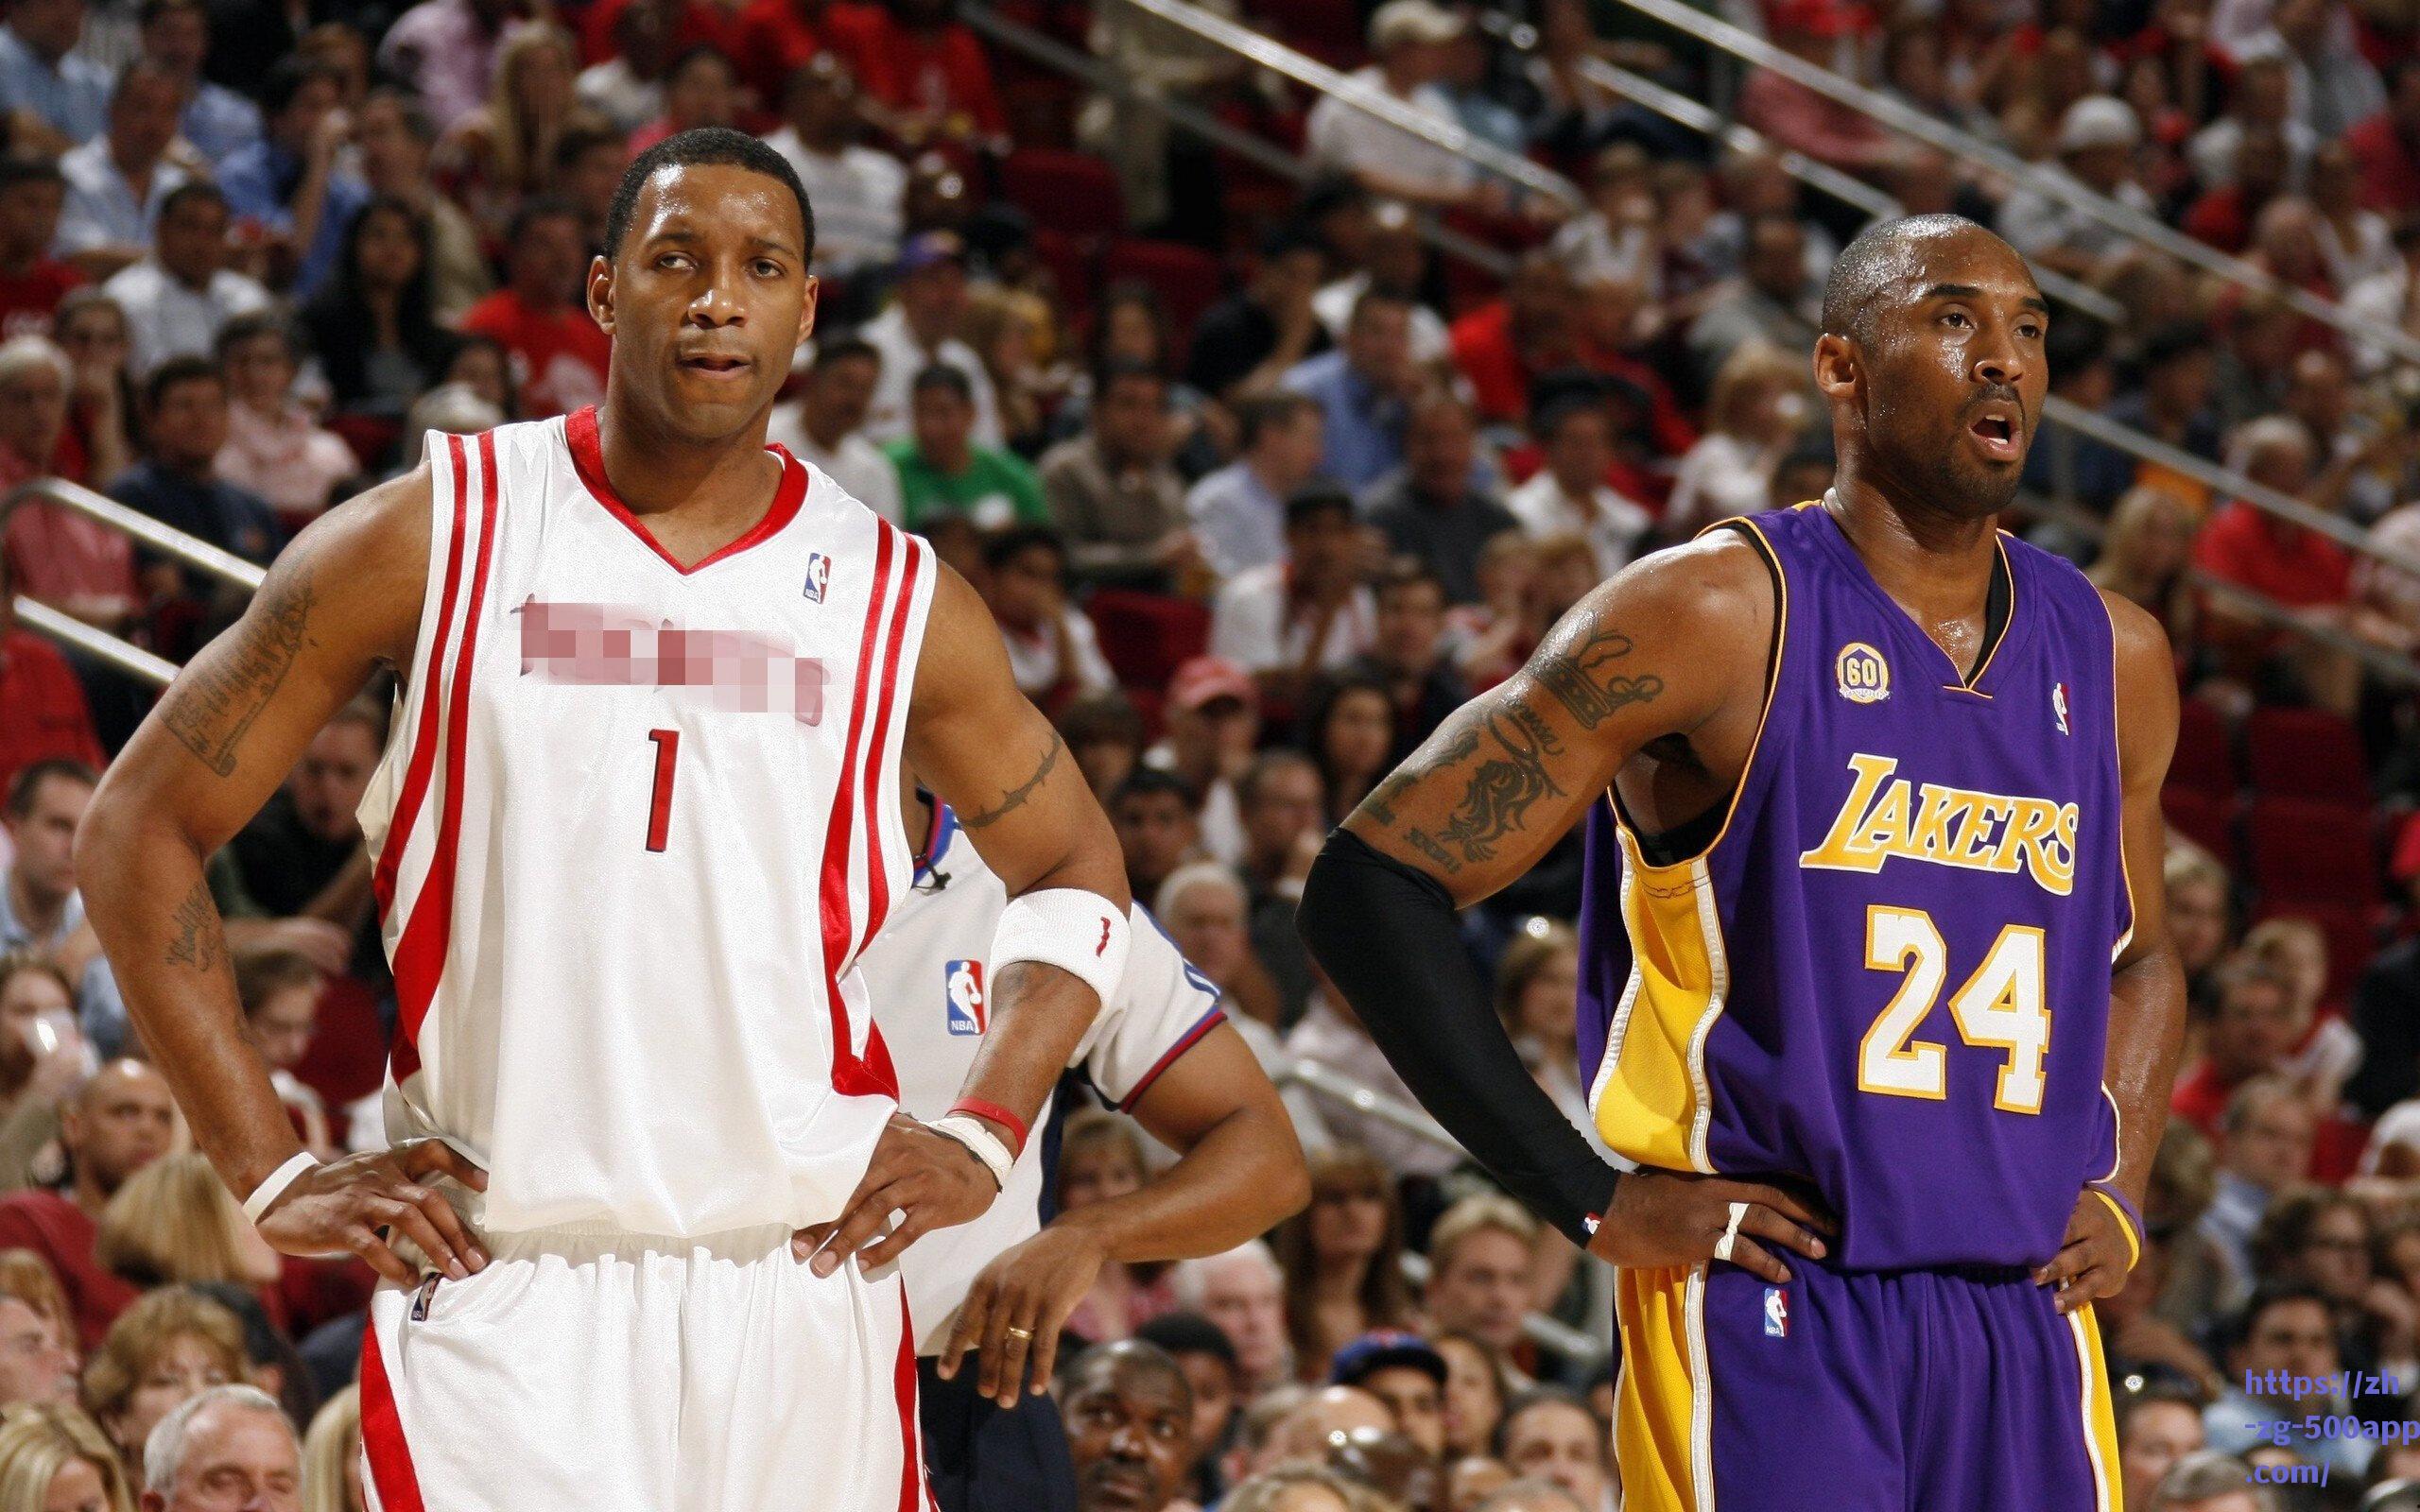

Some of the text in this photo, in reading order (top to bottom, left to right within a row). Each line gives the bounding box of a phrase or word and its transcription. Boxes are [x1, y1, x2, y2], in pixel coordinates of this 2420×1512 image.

[1846, 658, 1877, 687] 60
[646, 729, 680, 852] 1
[1799, 752, 2079, 896] LAKERS
[951, 1021, 974, 1031] NBA
[1858, 904, 2051, 1115] 24
